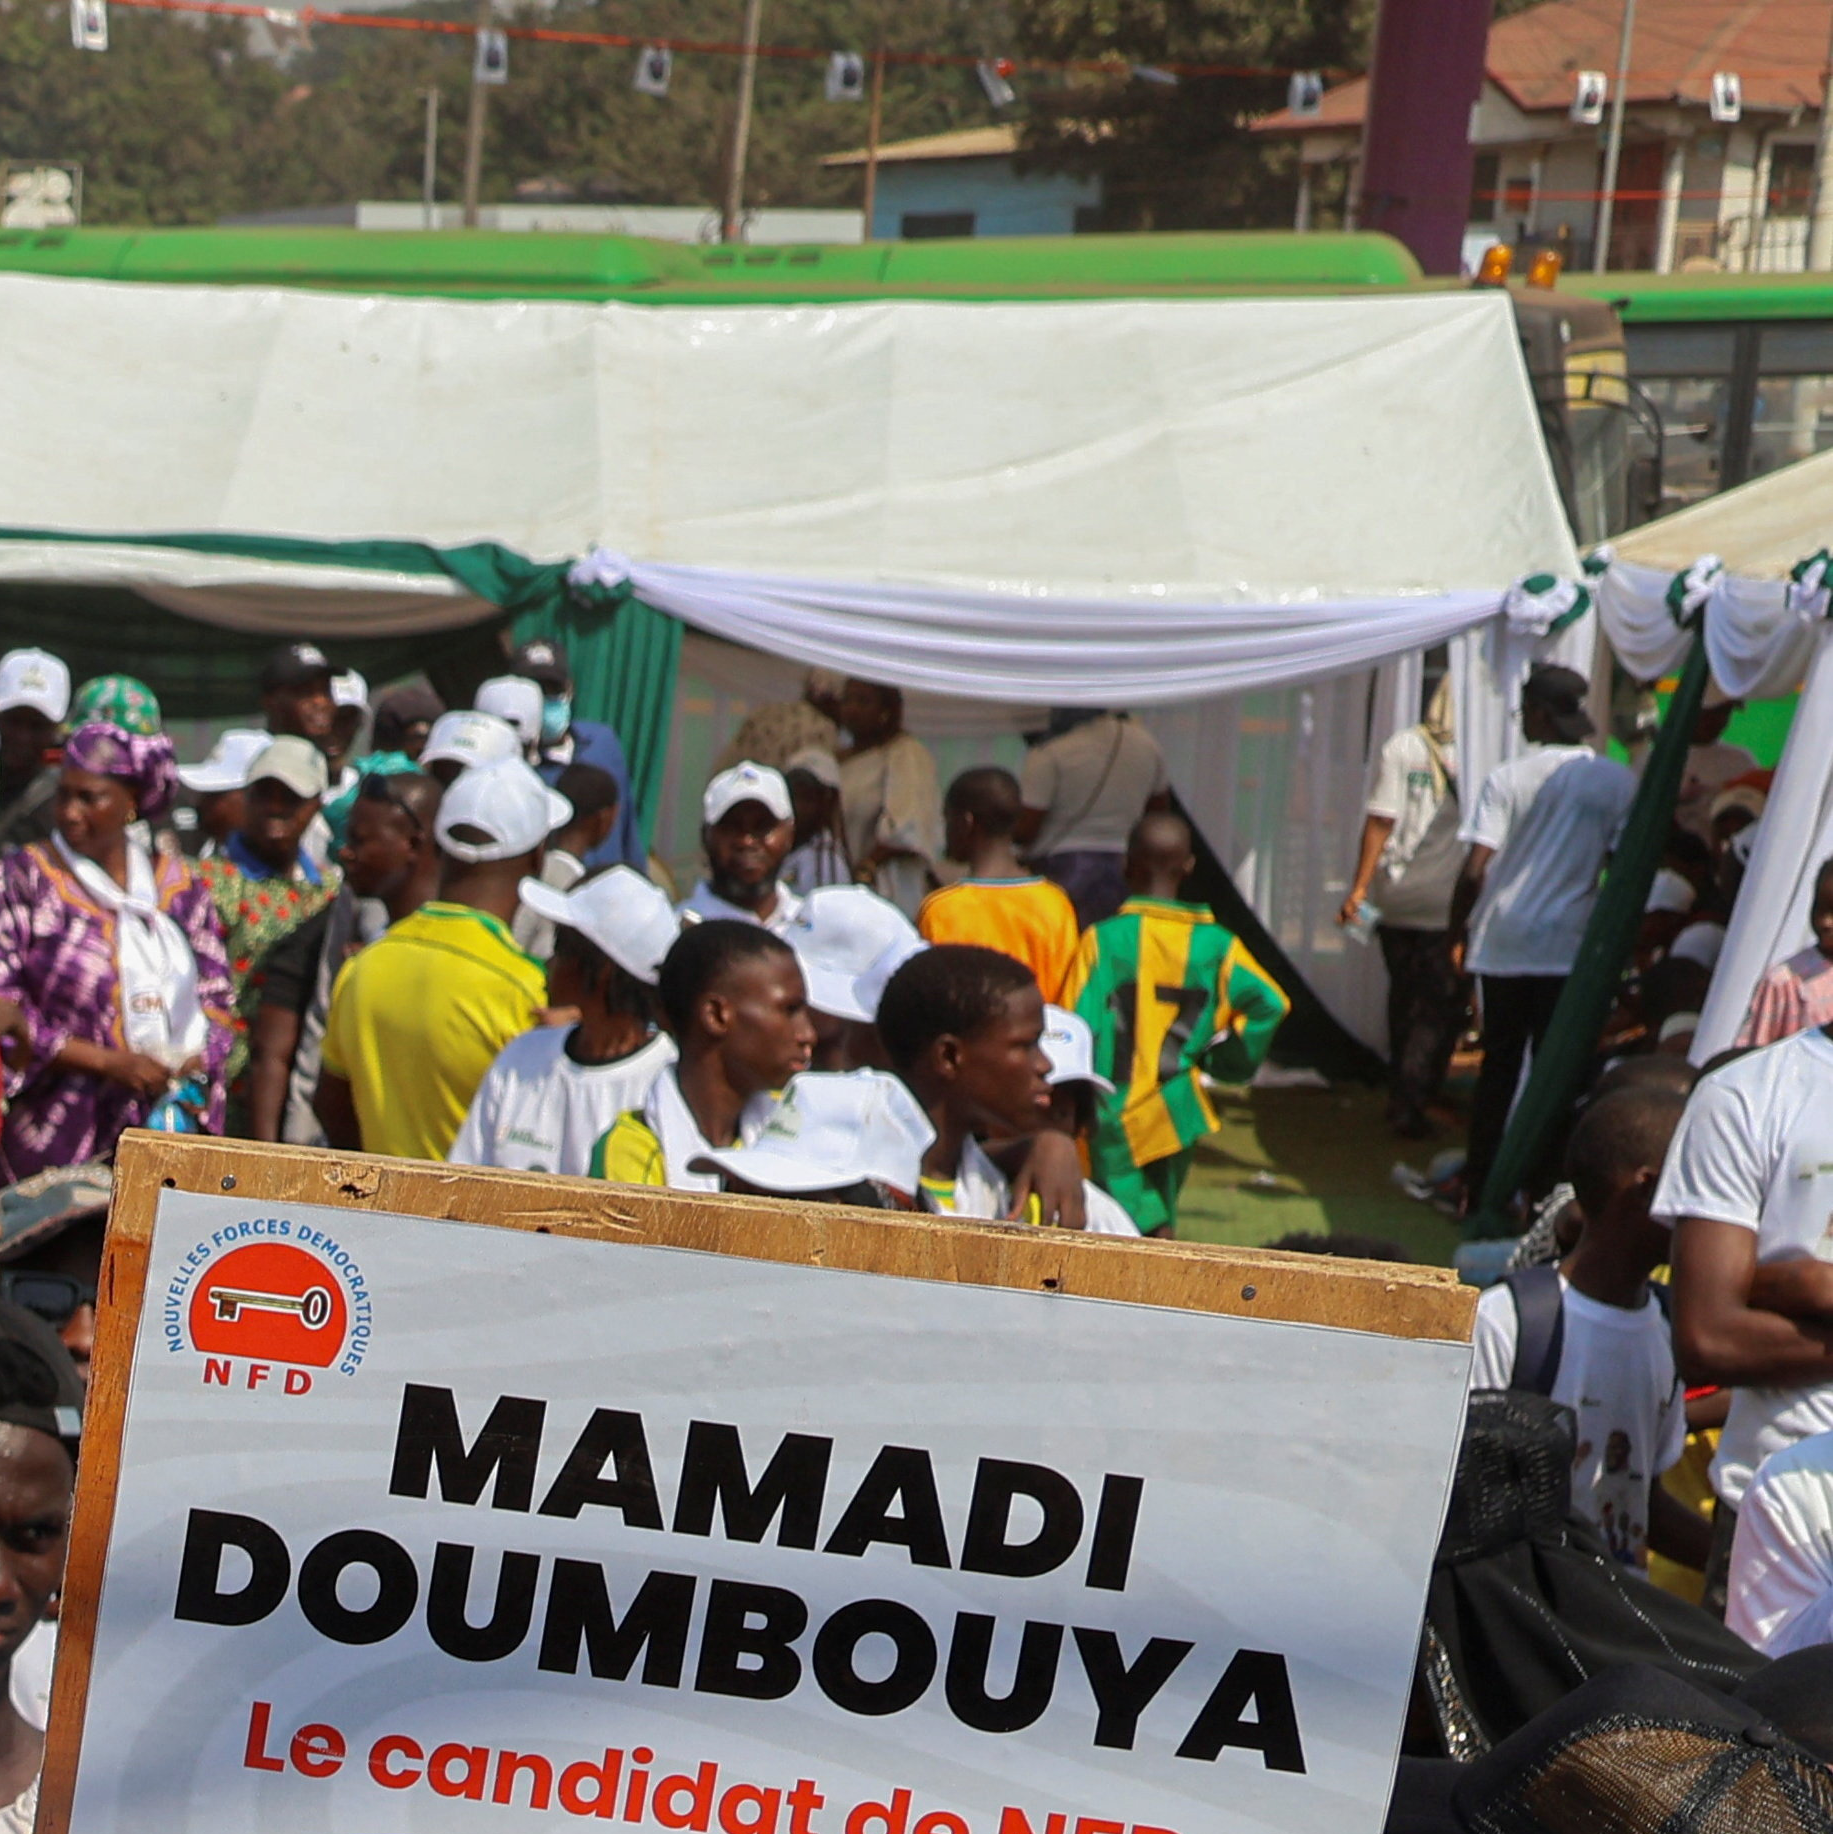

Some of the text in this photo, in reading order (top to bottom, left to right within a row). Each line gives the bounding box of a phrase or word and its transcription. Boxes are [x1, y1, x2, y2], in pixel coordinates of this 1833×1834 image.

[164, 1218, 373, 1377] NOUVELLES FORCES DEMOCRATIQUES
[388, 1382, 1146, 1595] MAMADI
[173, 1507, 1309, 1776] DOUMBOUYA
[243, 1701, 345, 1781] Le
